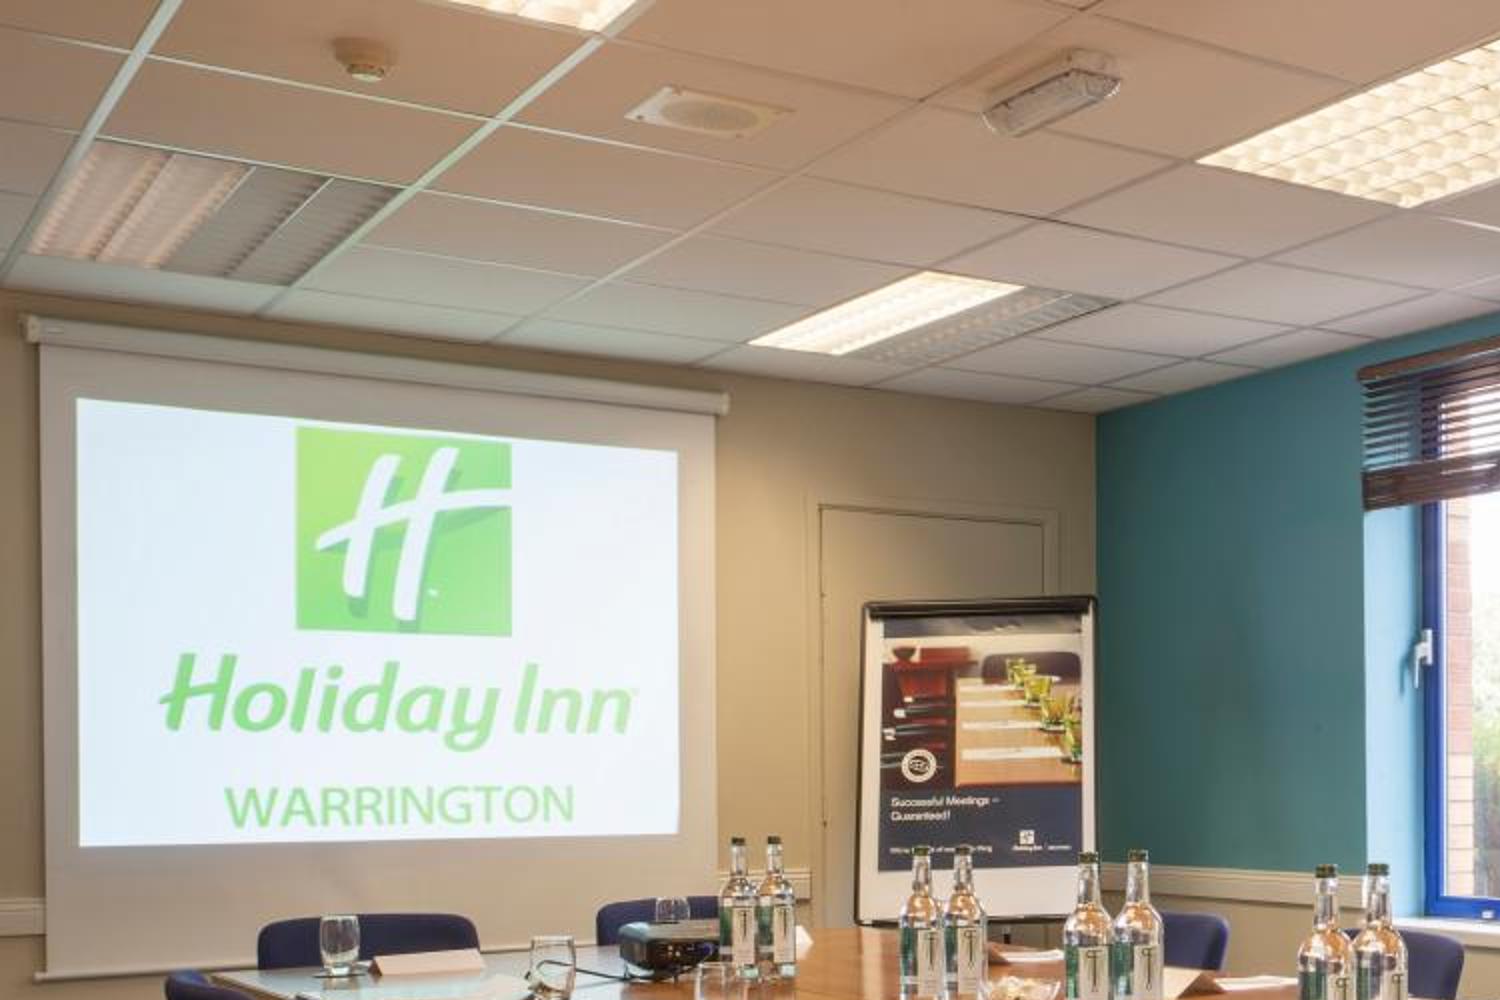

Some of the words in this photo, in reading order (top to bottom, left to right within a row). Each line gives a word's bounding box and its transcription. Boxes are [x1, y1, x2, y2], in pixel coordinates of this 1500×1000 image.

[316, 447, 512, 621] H
[159, 652, 501, 753] Holiday
[513, 662, 633, 735] Inn
[224, 785, 574, 829] WARRINGTON
